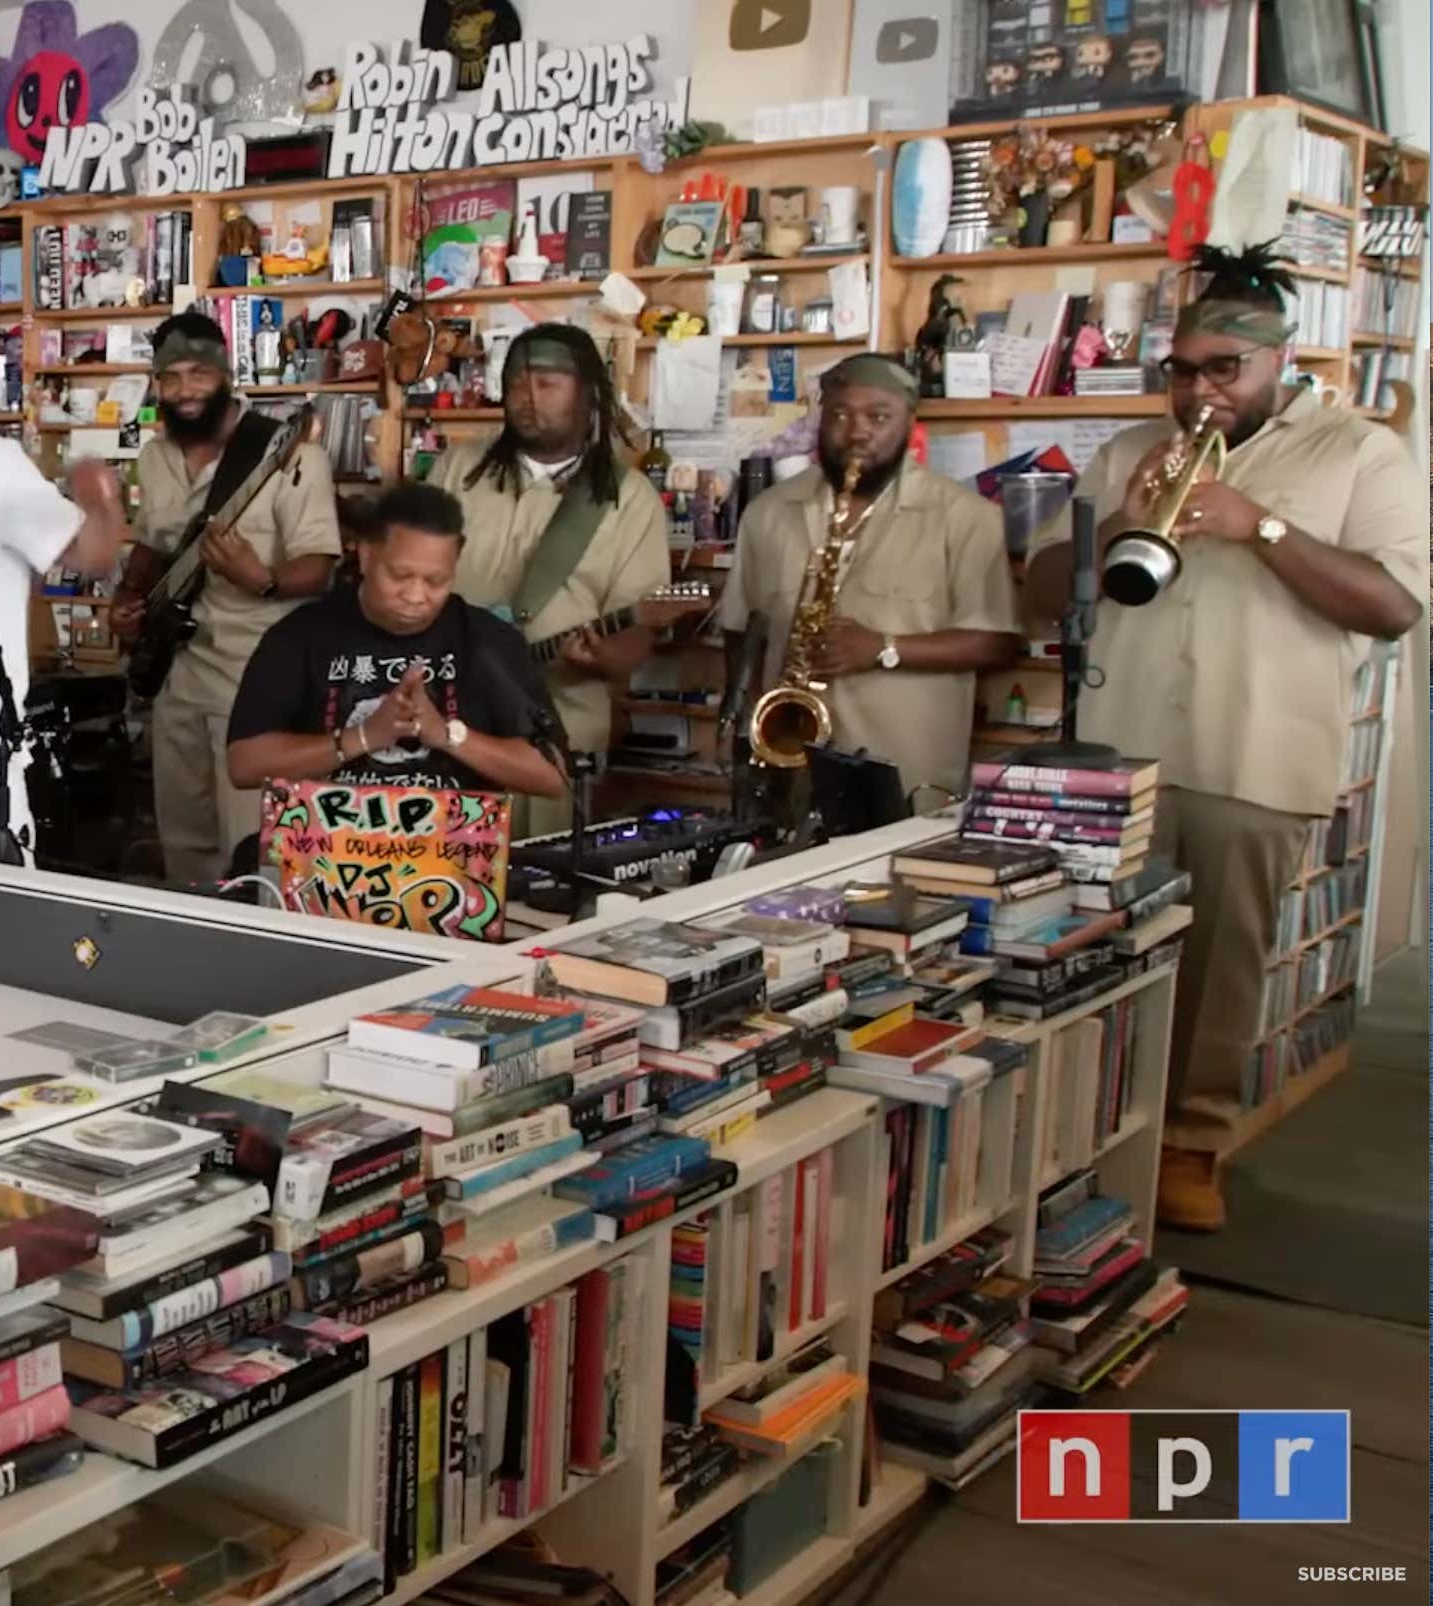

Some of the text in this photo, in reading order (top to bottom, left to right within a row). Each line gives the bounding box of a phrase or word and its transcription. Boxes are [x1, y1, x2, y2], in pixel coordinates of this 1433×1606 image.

[338, 34, 651, 120] Robin Allsongs
[135, 85, 197, 144] Bob
[328, 103, 475, 179] Hilton
[39, 122, 135, 192] NPR
[147, 117, 247, 195] Boilen
[315, 788, 435, 834] R.I.P.
[287, 836, 500, 862] NEW ORLEANS LEGEND
[614, 848, 698, 883] novation
[459, 1143, 476, 1163] ART
